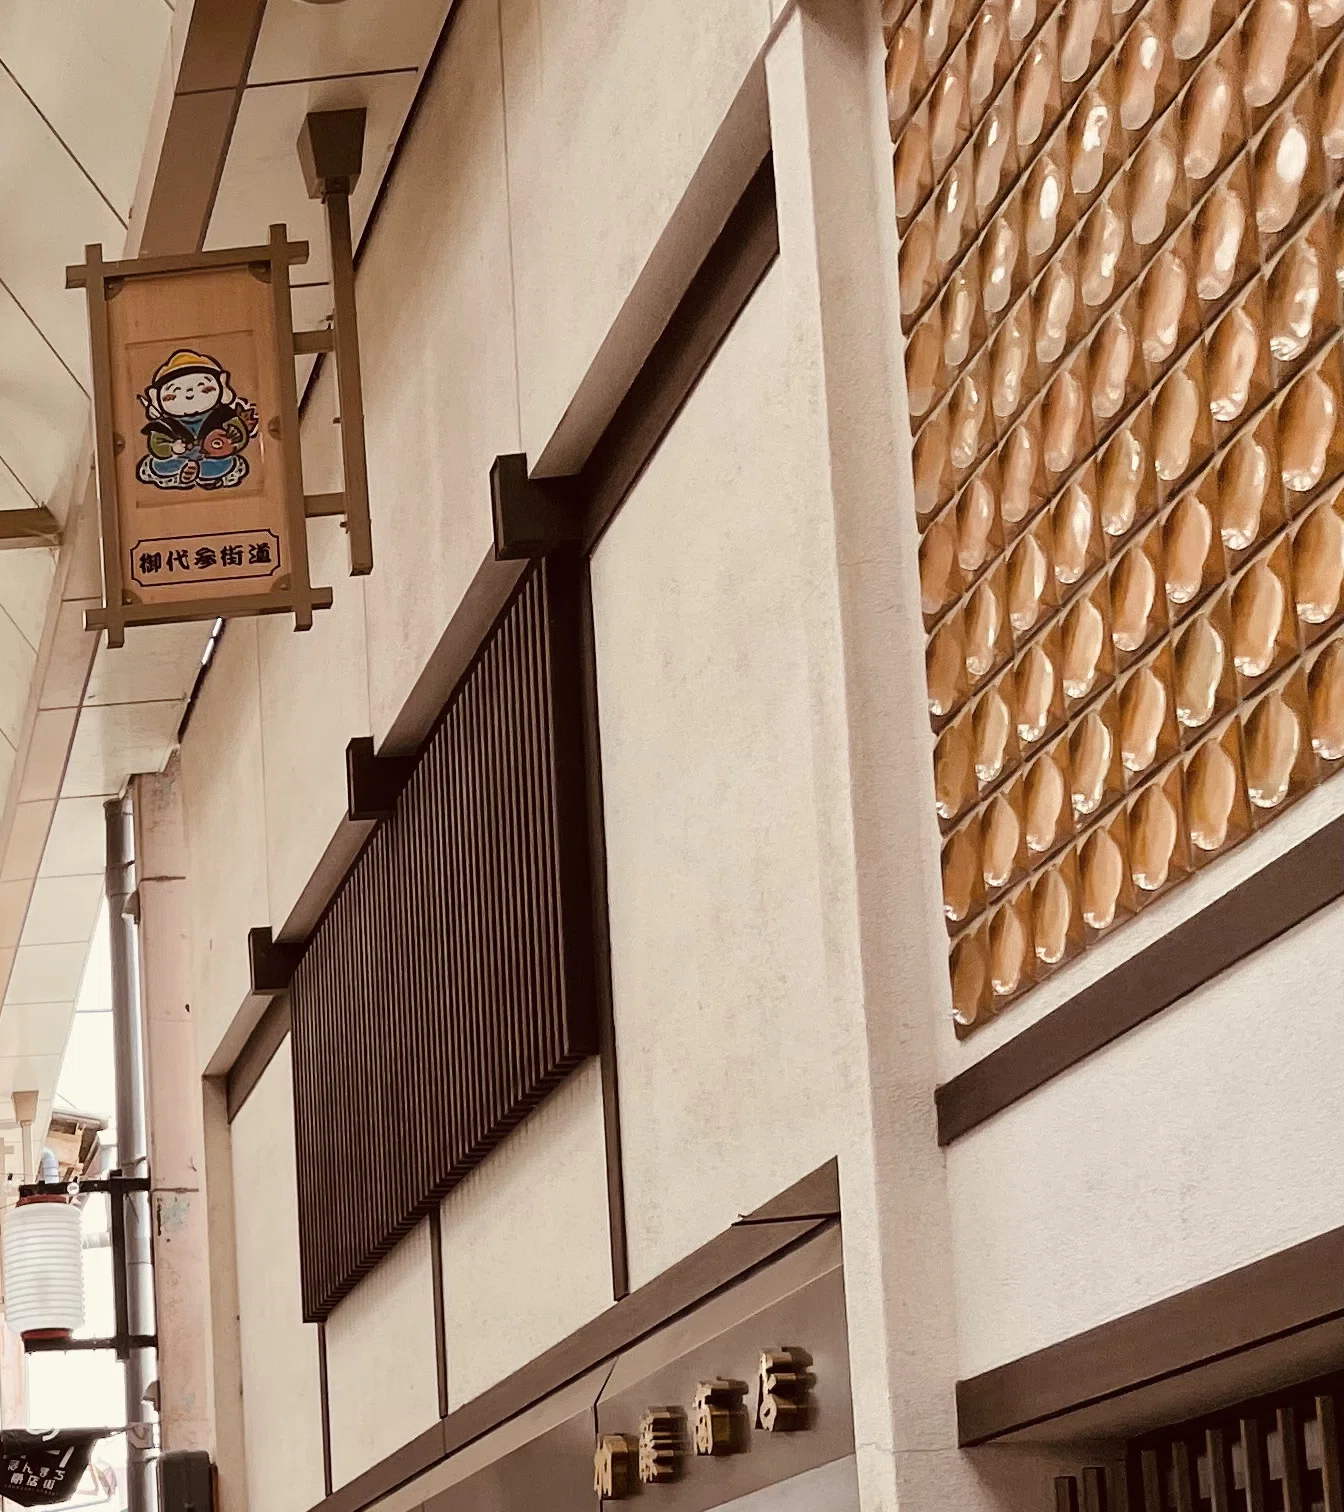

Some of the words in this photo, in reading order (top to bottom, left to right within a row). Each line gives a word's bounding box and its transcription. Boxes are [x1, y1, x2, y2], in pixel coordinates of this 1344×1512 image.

[138, 541, 273, 574] 御代参街道
